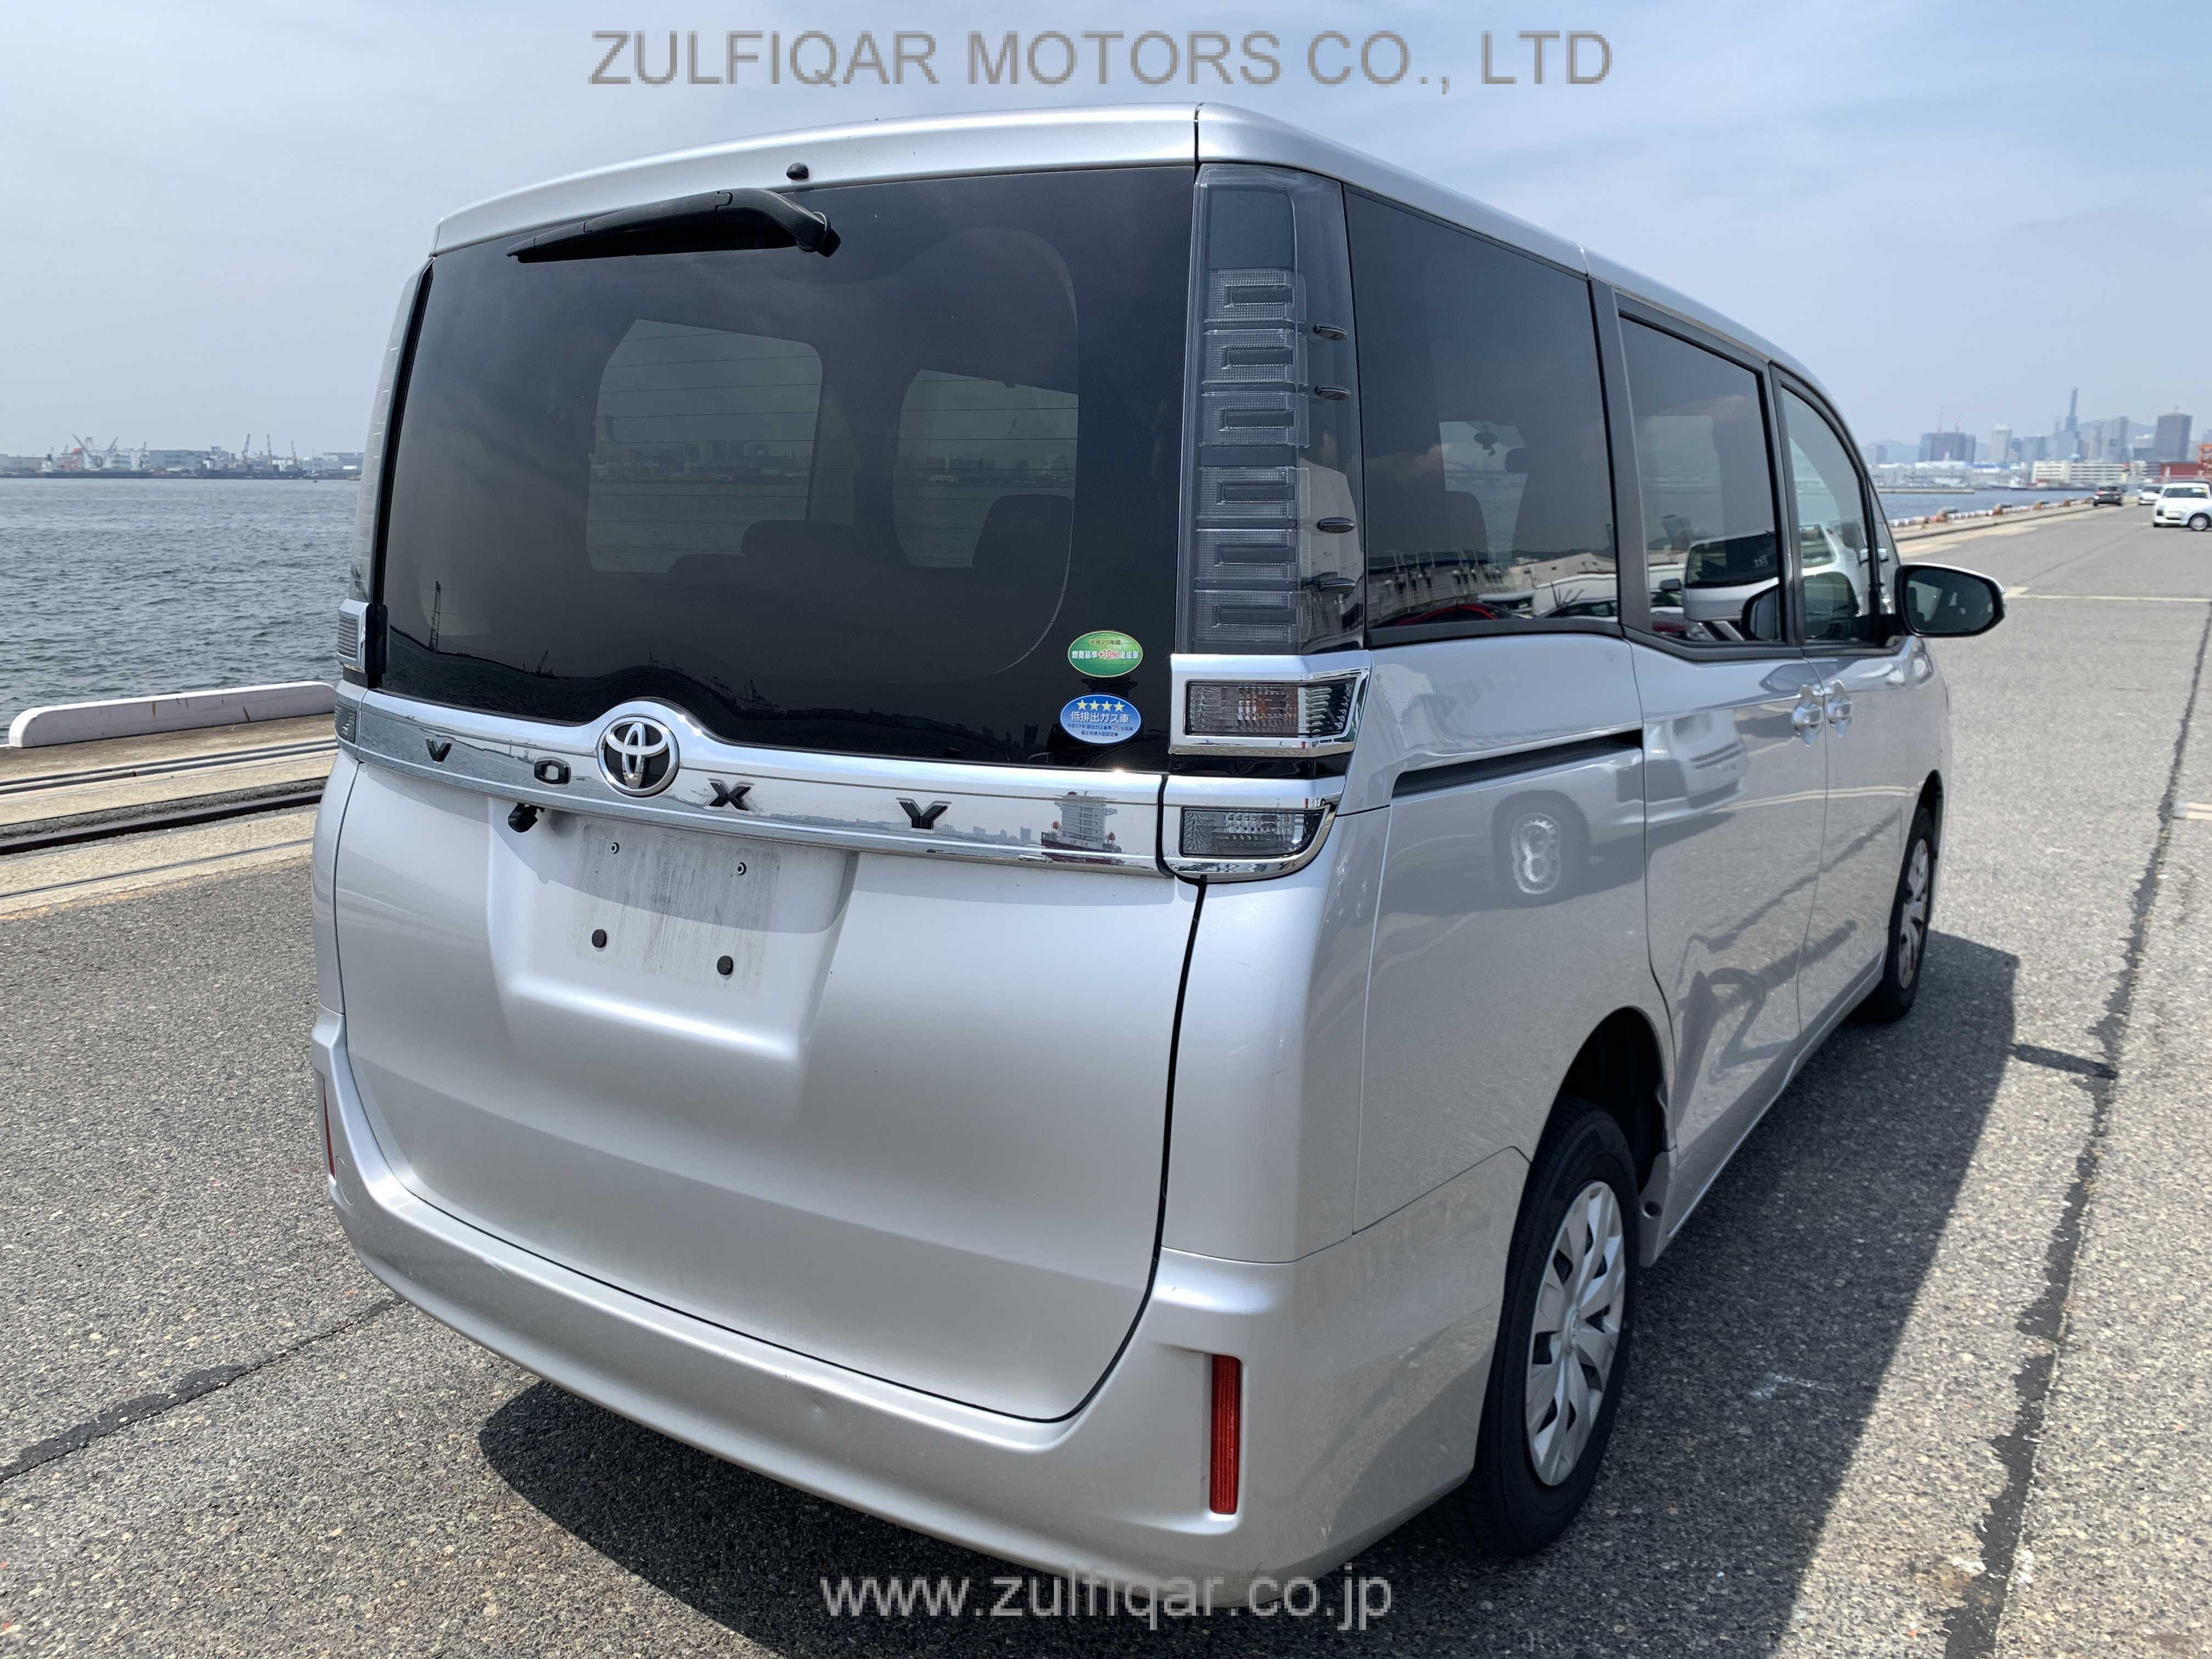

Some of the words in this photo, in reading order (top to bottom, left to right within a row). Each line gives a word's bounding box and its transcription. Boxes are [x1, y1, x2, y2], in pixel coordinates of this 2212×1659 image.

[1071, 710, 1130, 724] 低排出ガス車
[425, 736, 951, 831] VOXY
